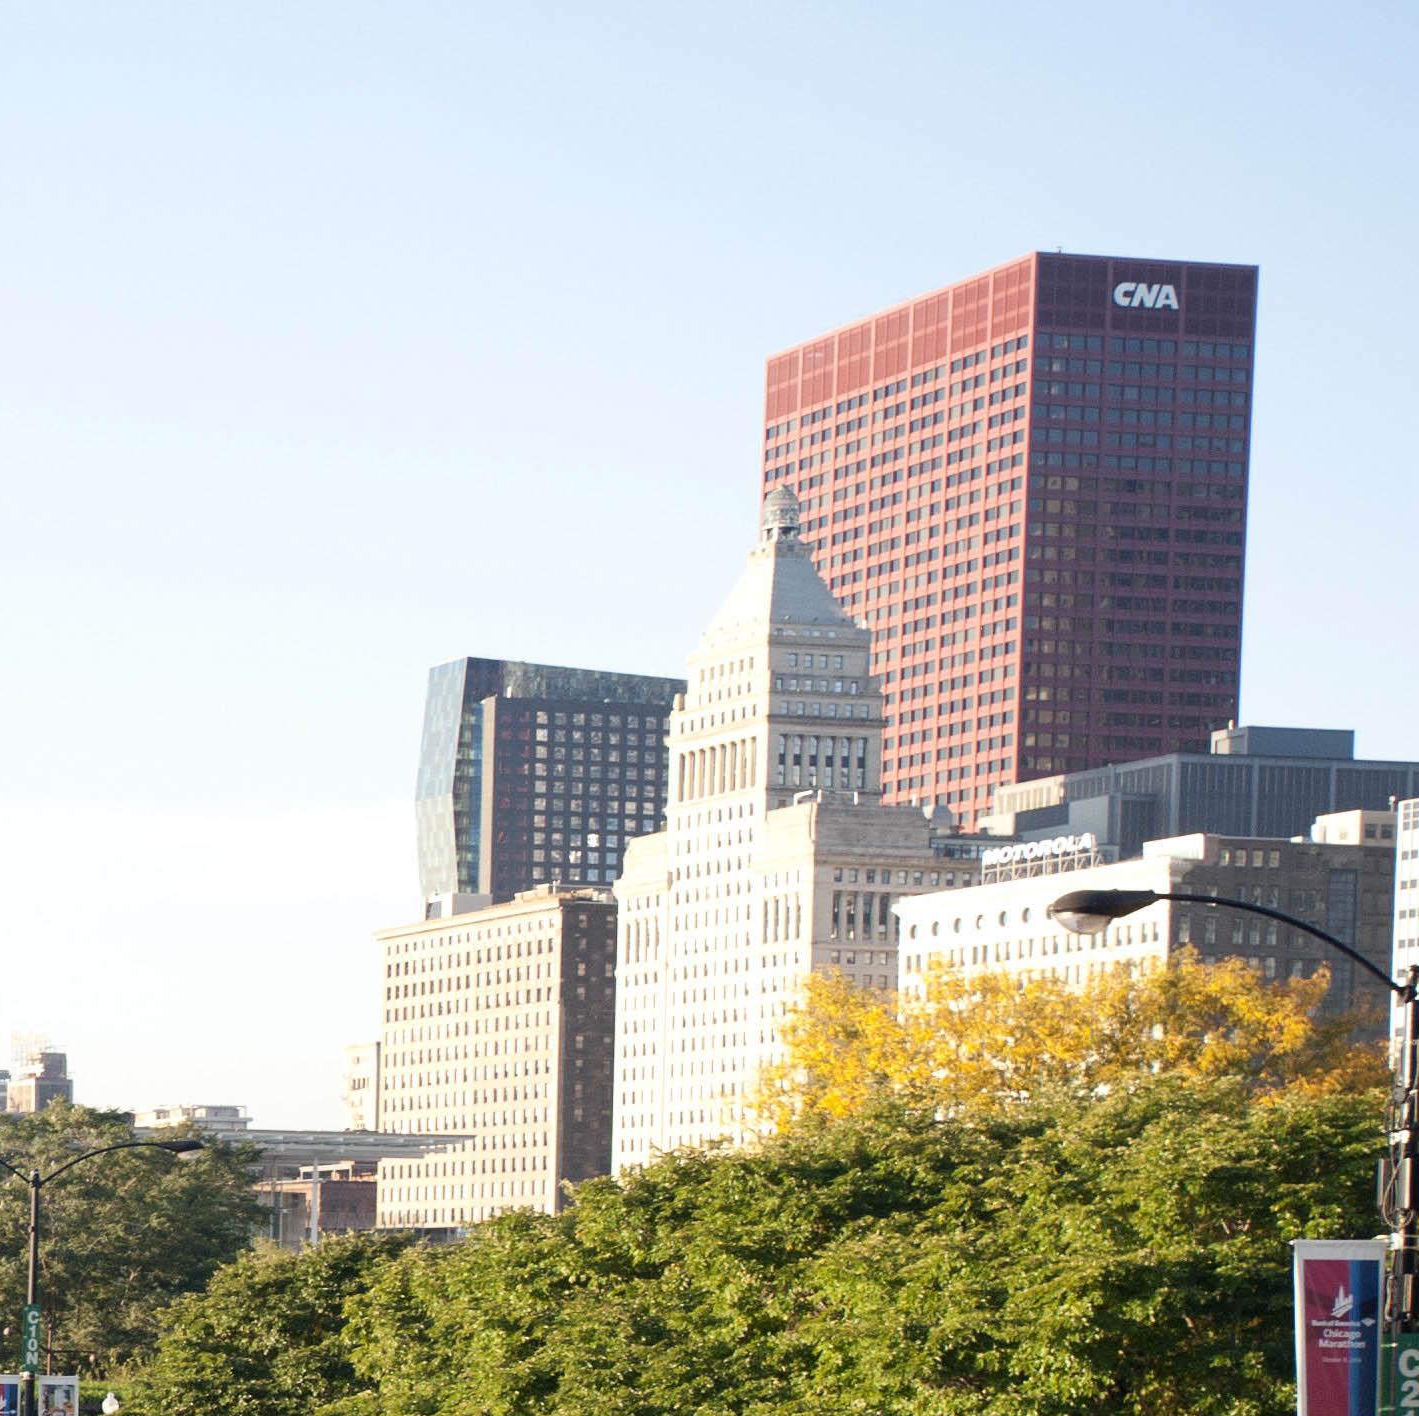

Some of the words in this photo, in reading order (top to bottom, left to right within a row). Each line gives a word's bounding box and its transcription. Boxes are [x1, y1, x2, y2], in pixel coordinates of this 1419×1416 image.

[1113, 282, 1180, 310] CNA
[27, 1310, 39, 1365] C10N
[1319, 1339, 1366, 1349] Marathon
[1323, 1328, 1361, 1340] Chicago
